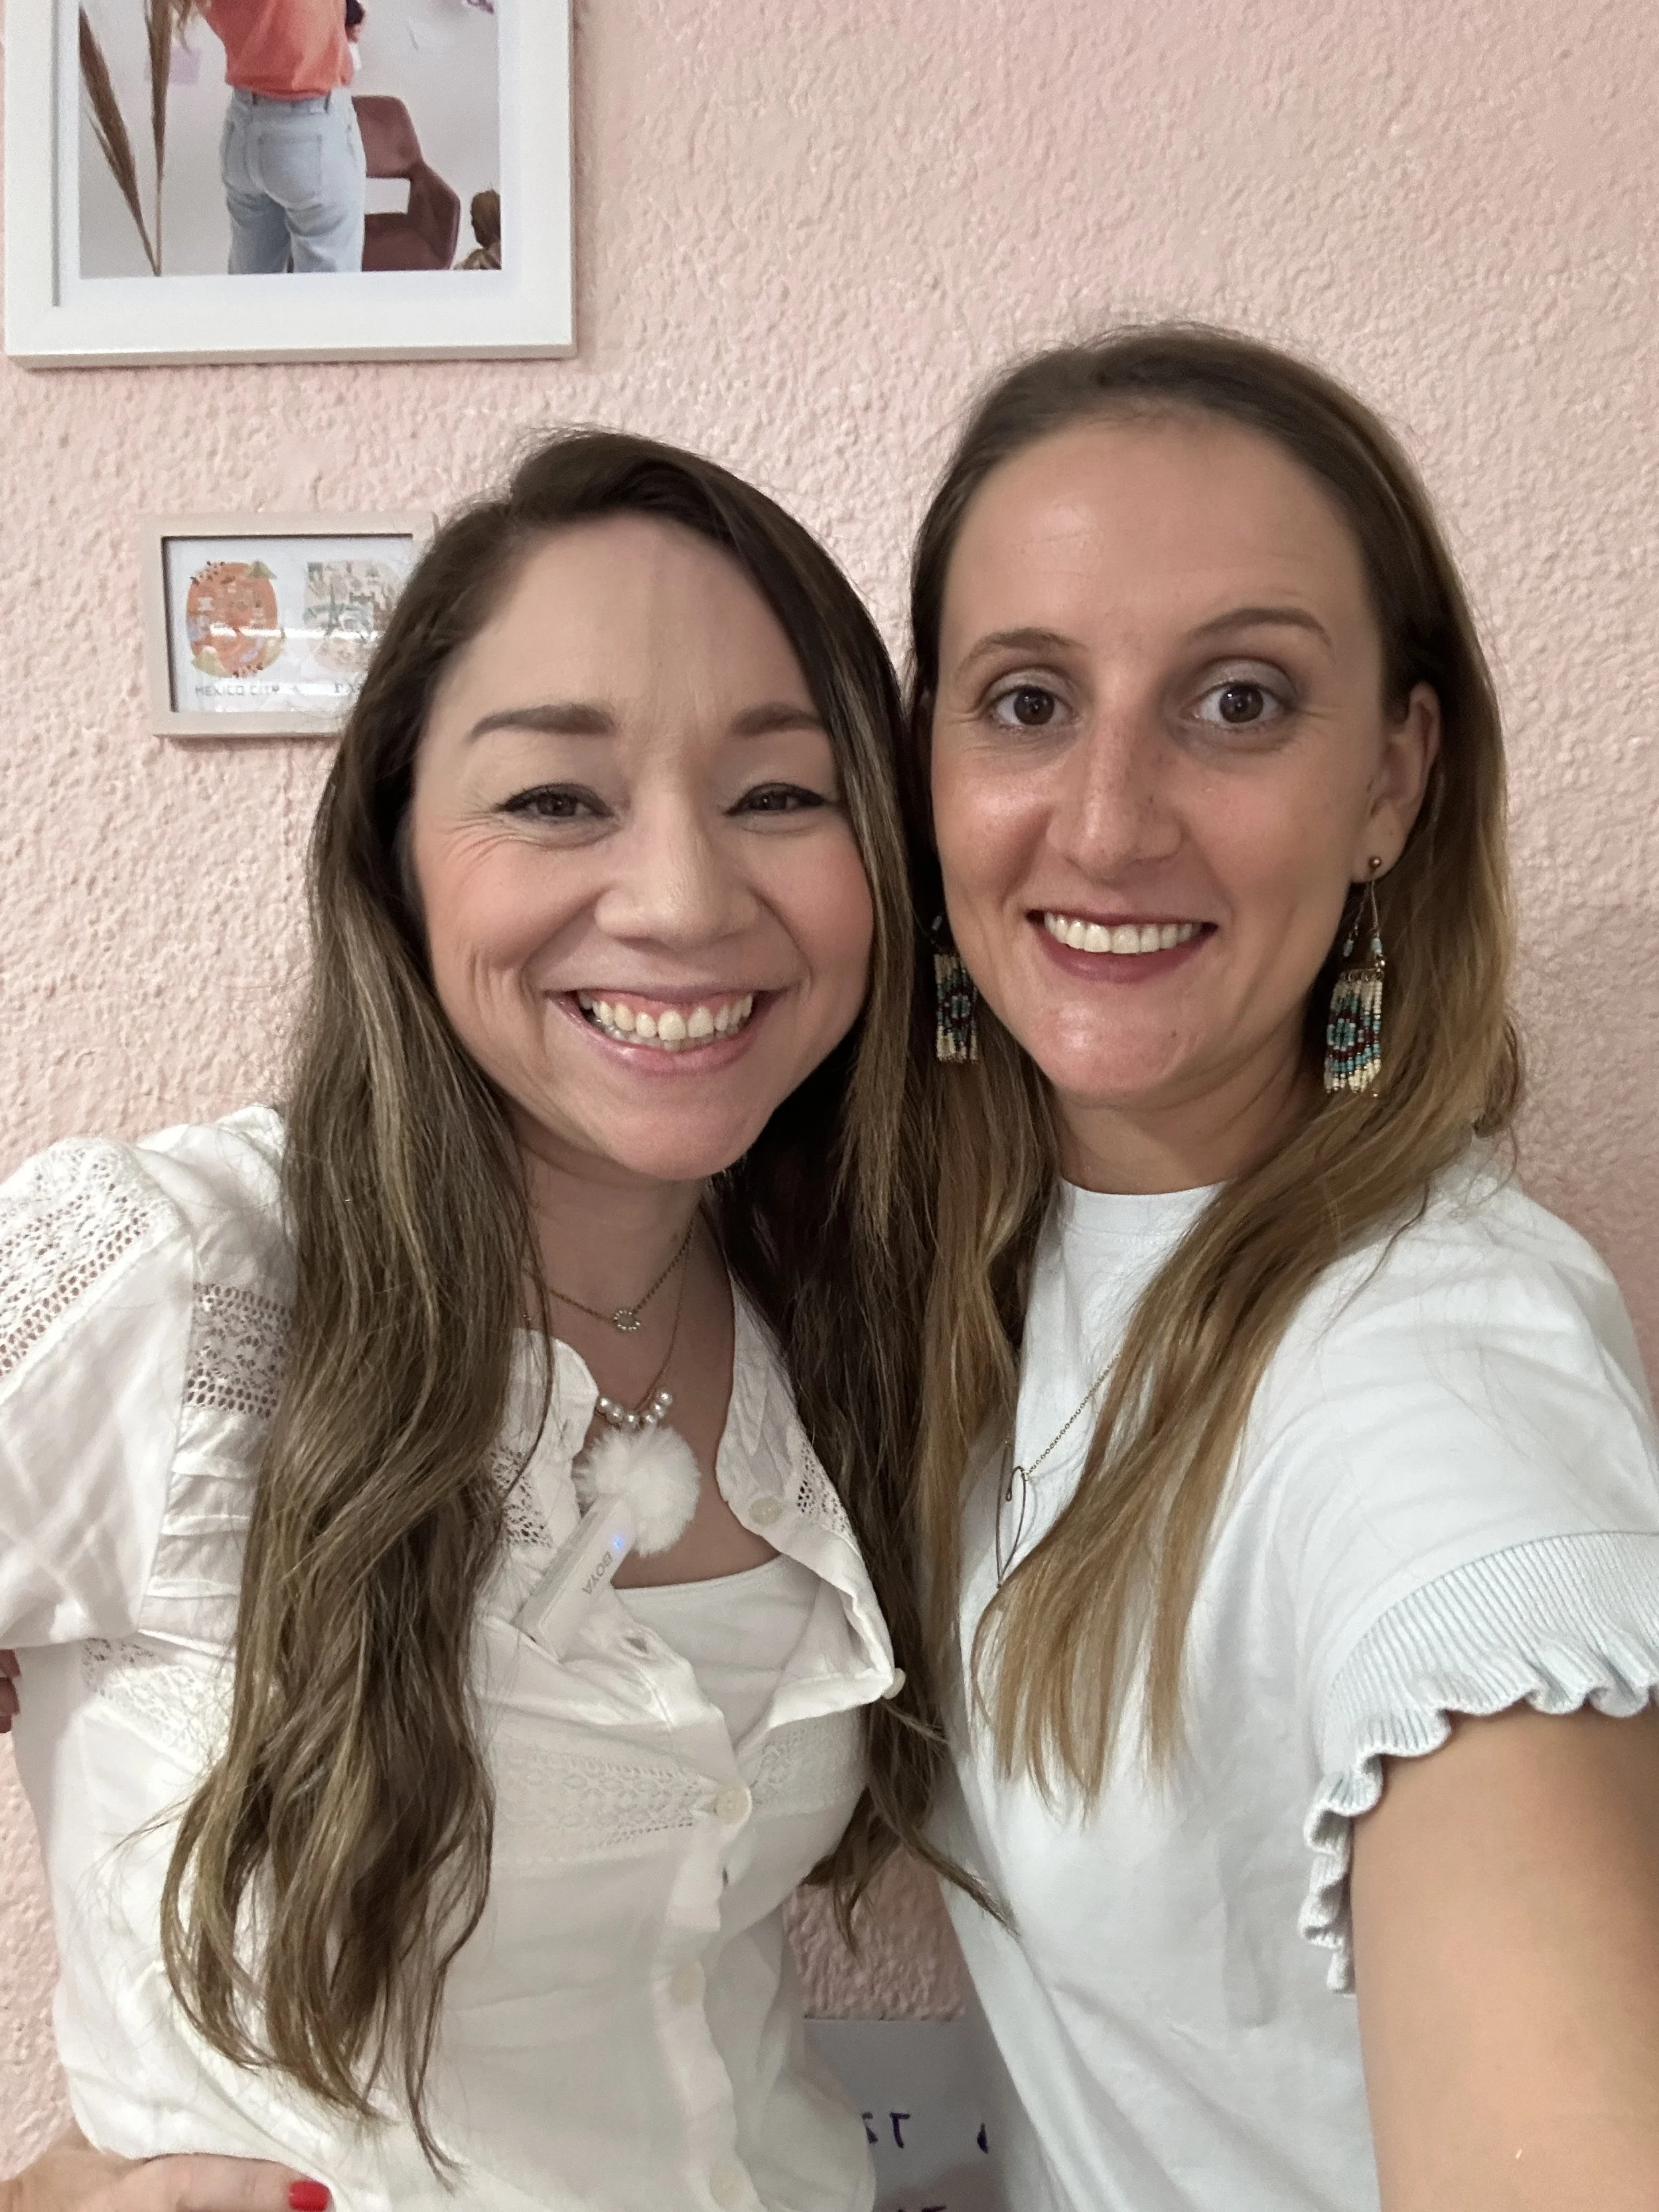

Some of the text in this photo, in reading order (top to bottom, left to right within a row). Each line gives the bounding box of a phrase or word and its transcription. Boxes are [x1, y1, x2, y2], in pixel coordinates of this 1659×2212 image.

[194, 684, 279, 697] MEXICO CITY
[582, 1550, 613, 1595] BOYA
